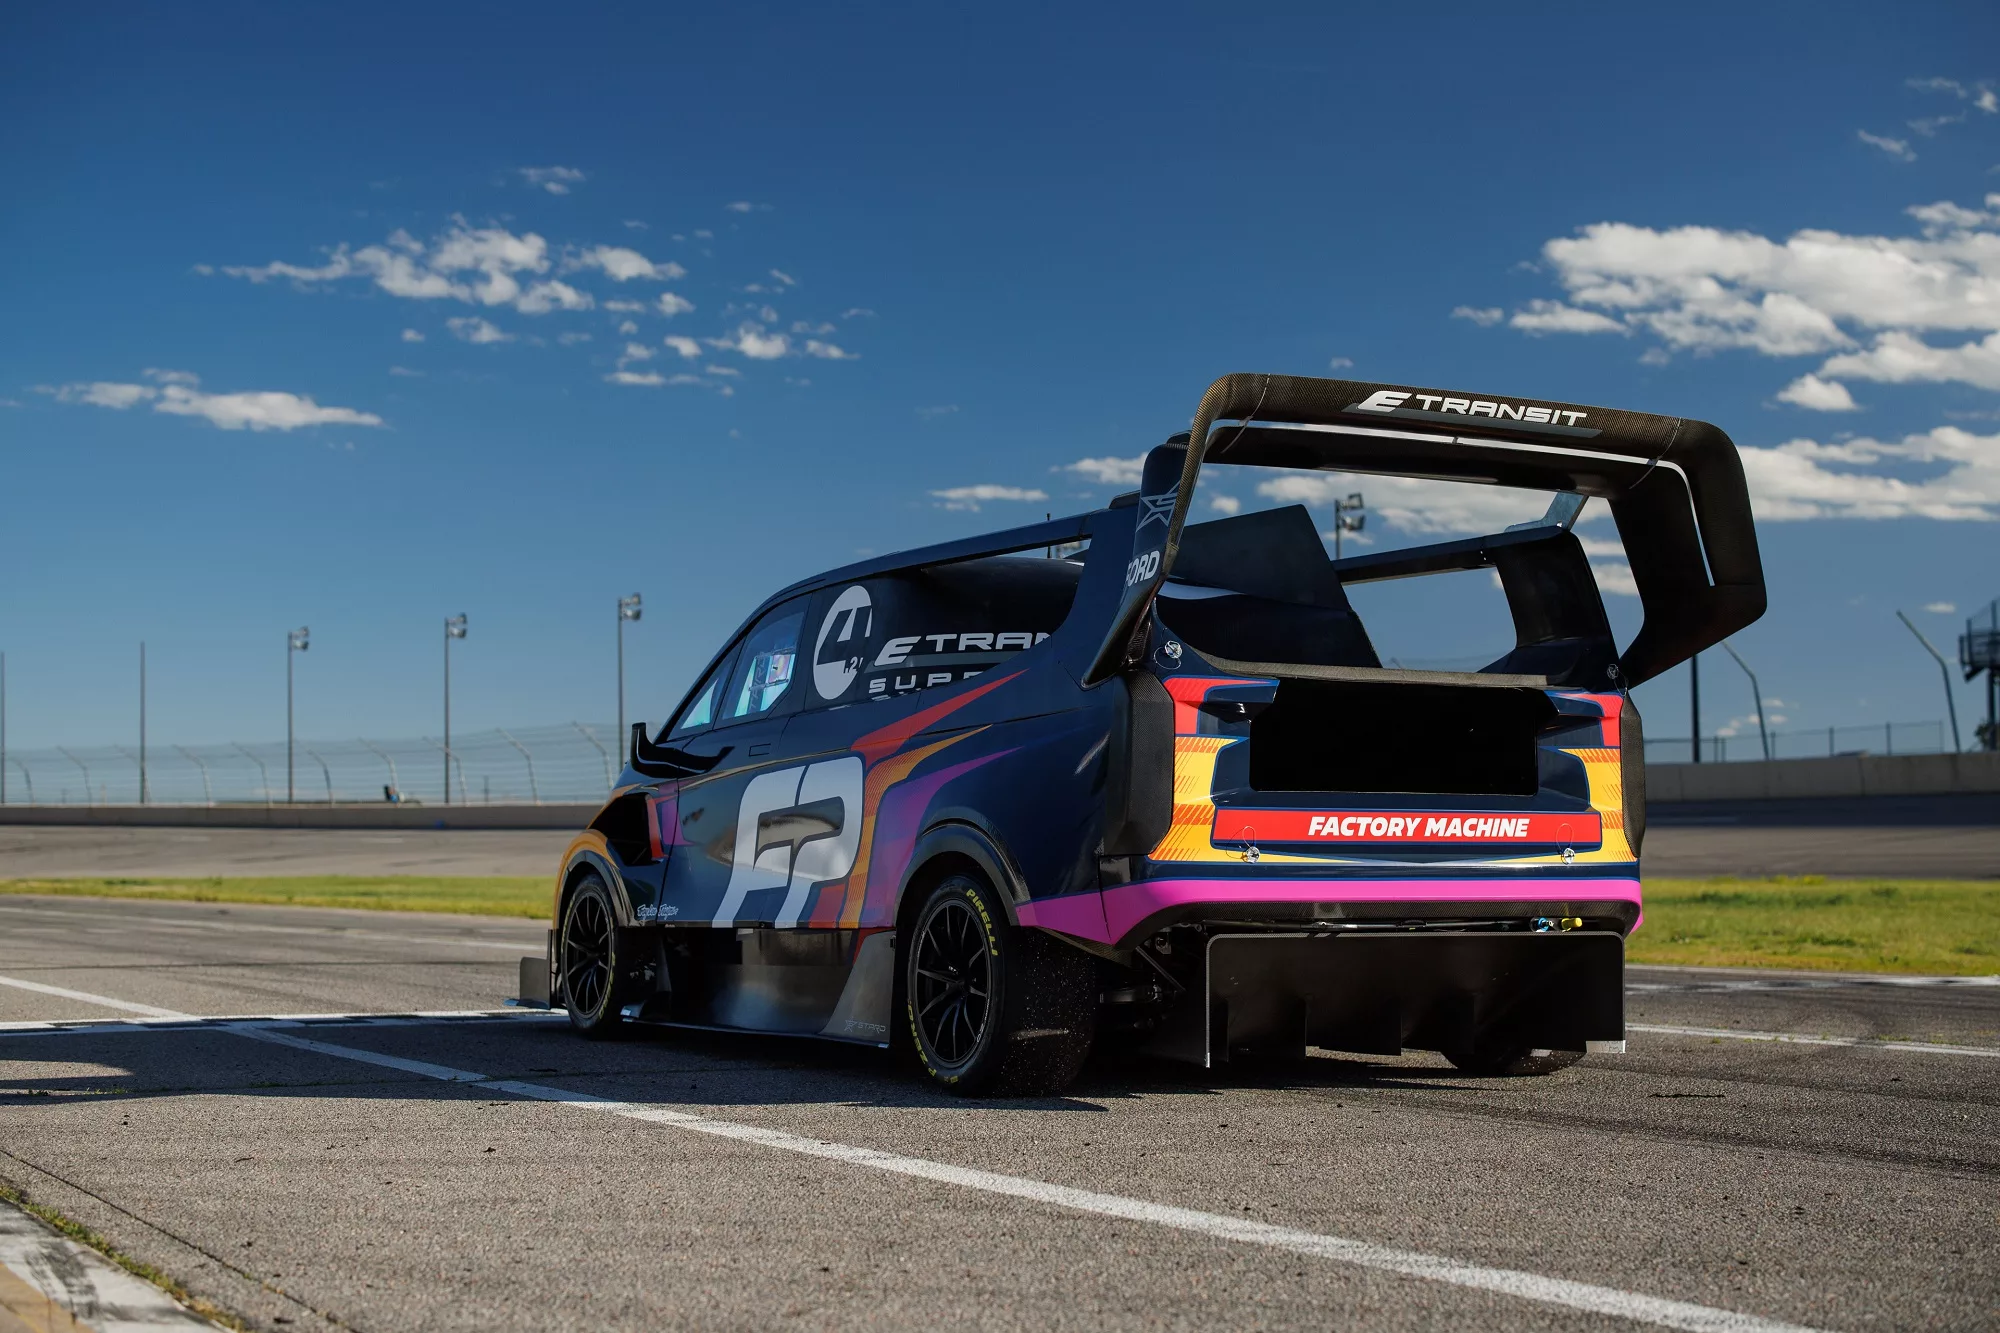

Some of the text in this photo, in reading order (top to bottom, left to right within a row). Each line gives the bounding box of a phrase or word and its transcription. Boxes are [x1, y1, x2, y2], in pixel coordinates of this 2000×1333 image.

[1415, 394, 1588, 426] TRANSIT
[1308, 816, 1531, 838] FACTORY MACHINE
[966, 888, 998, 956] PIRELLI
